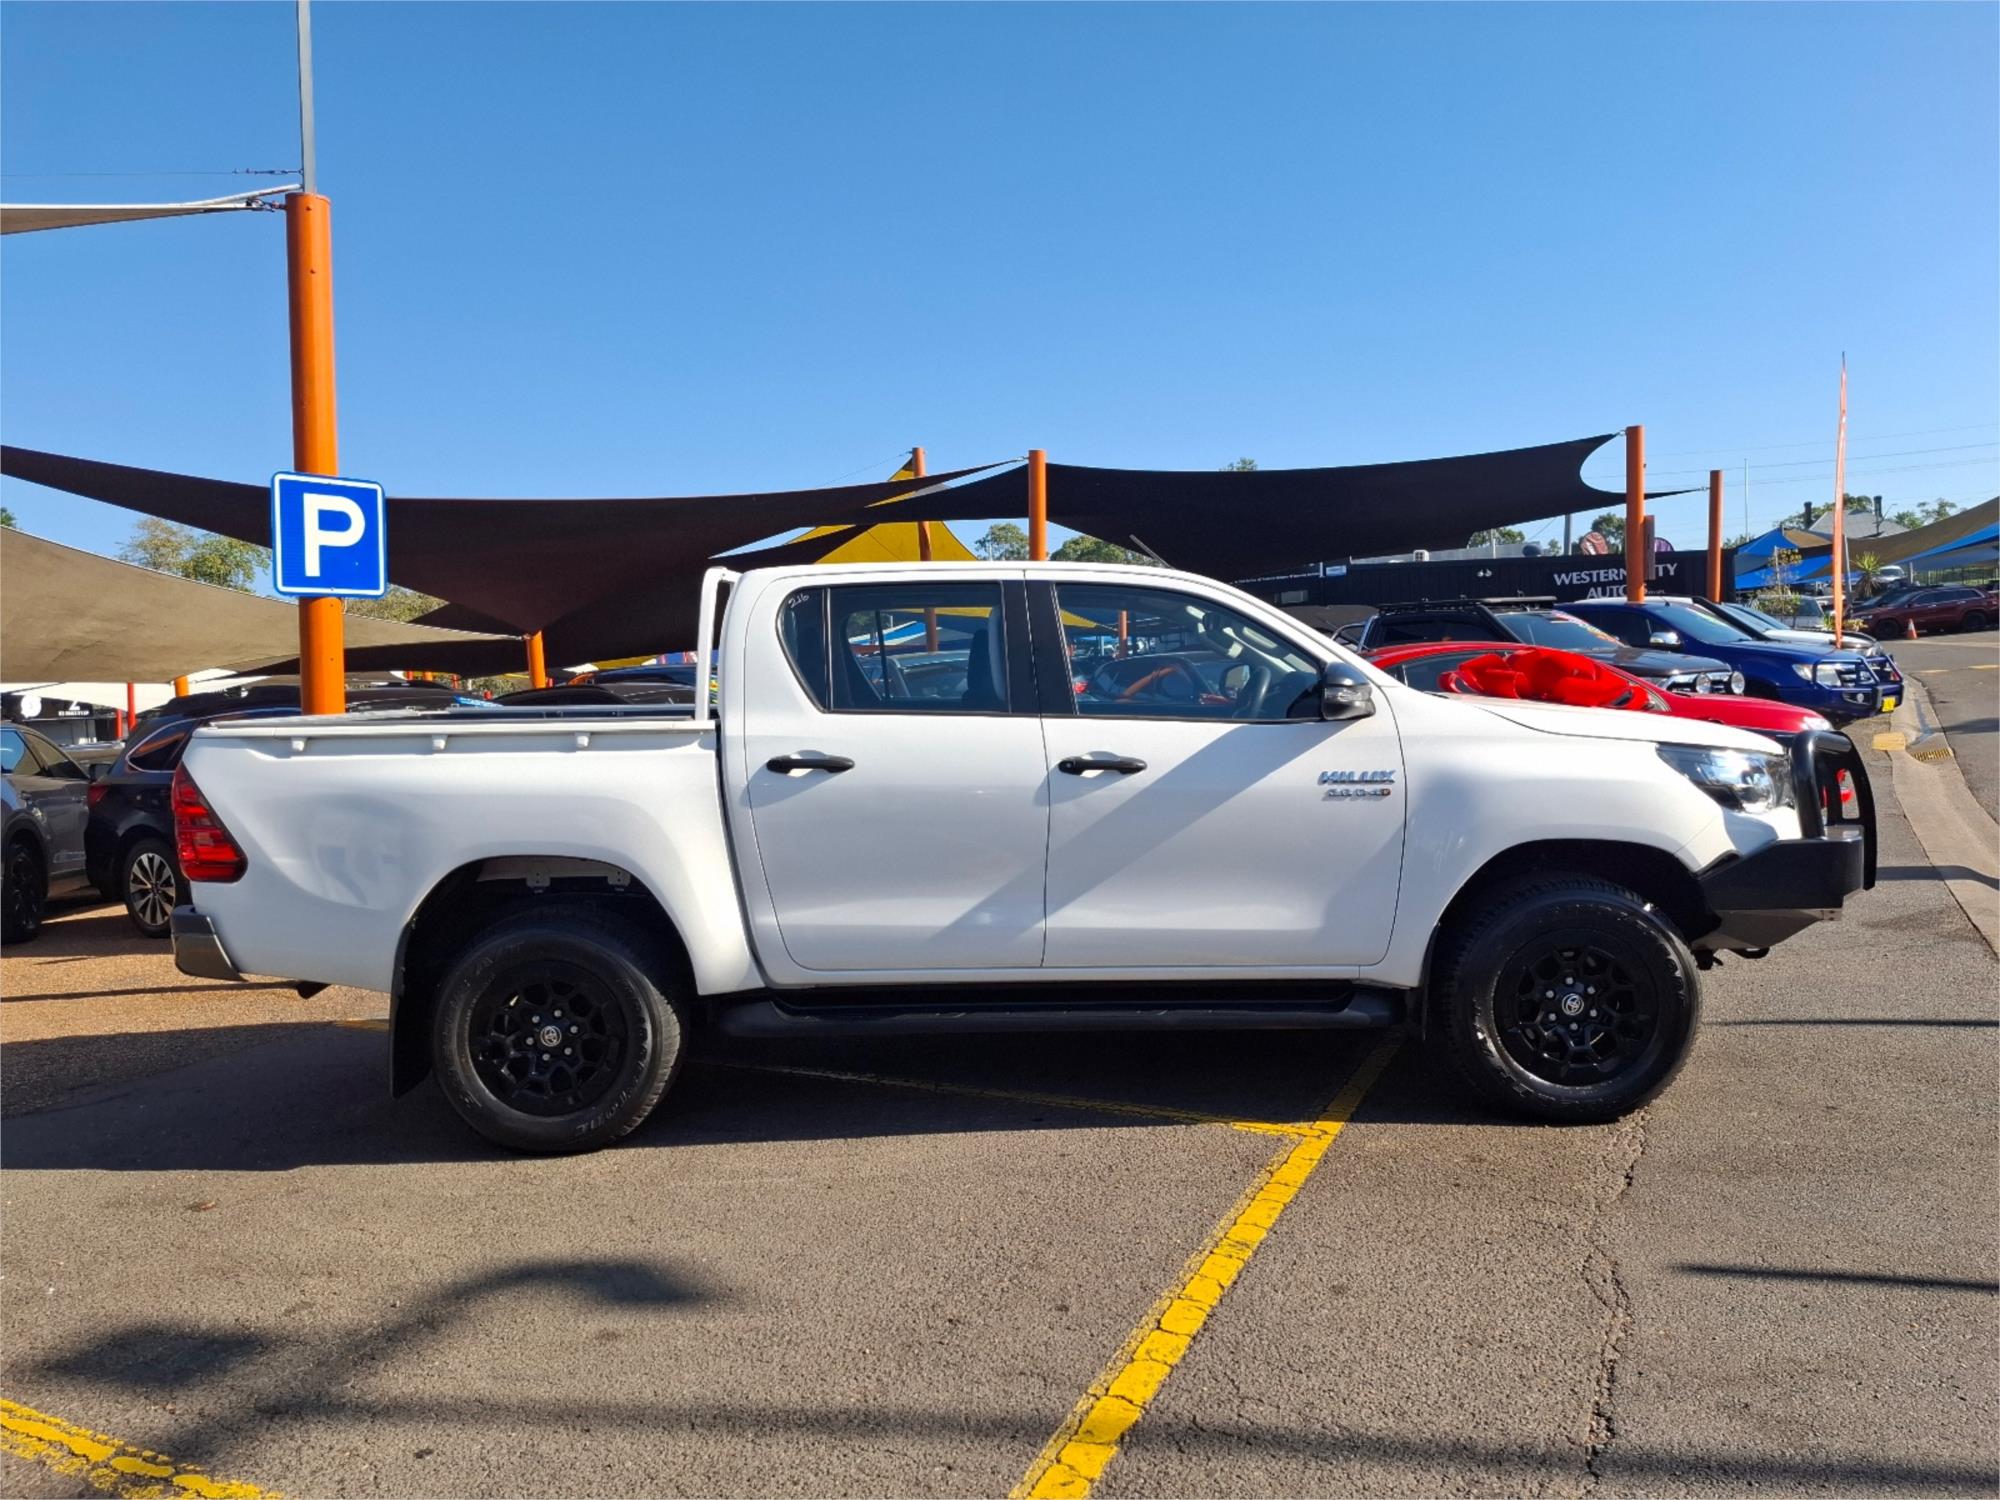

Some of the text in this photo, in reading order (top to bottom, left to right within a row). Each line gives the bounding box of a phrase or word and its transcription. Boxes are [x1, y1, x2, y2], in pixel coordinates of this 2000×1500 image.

[303, 492, 366, 577] P
[1553, 568, 1627, 586] WESTERN
[1318, 770, 1396, 784] HILUX
